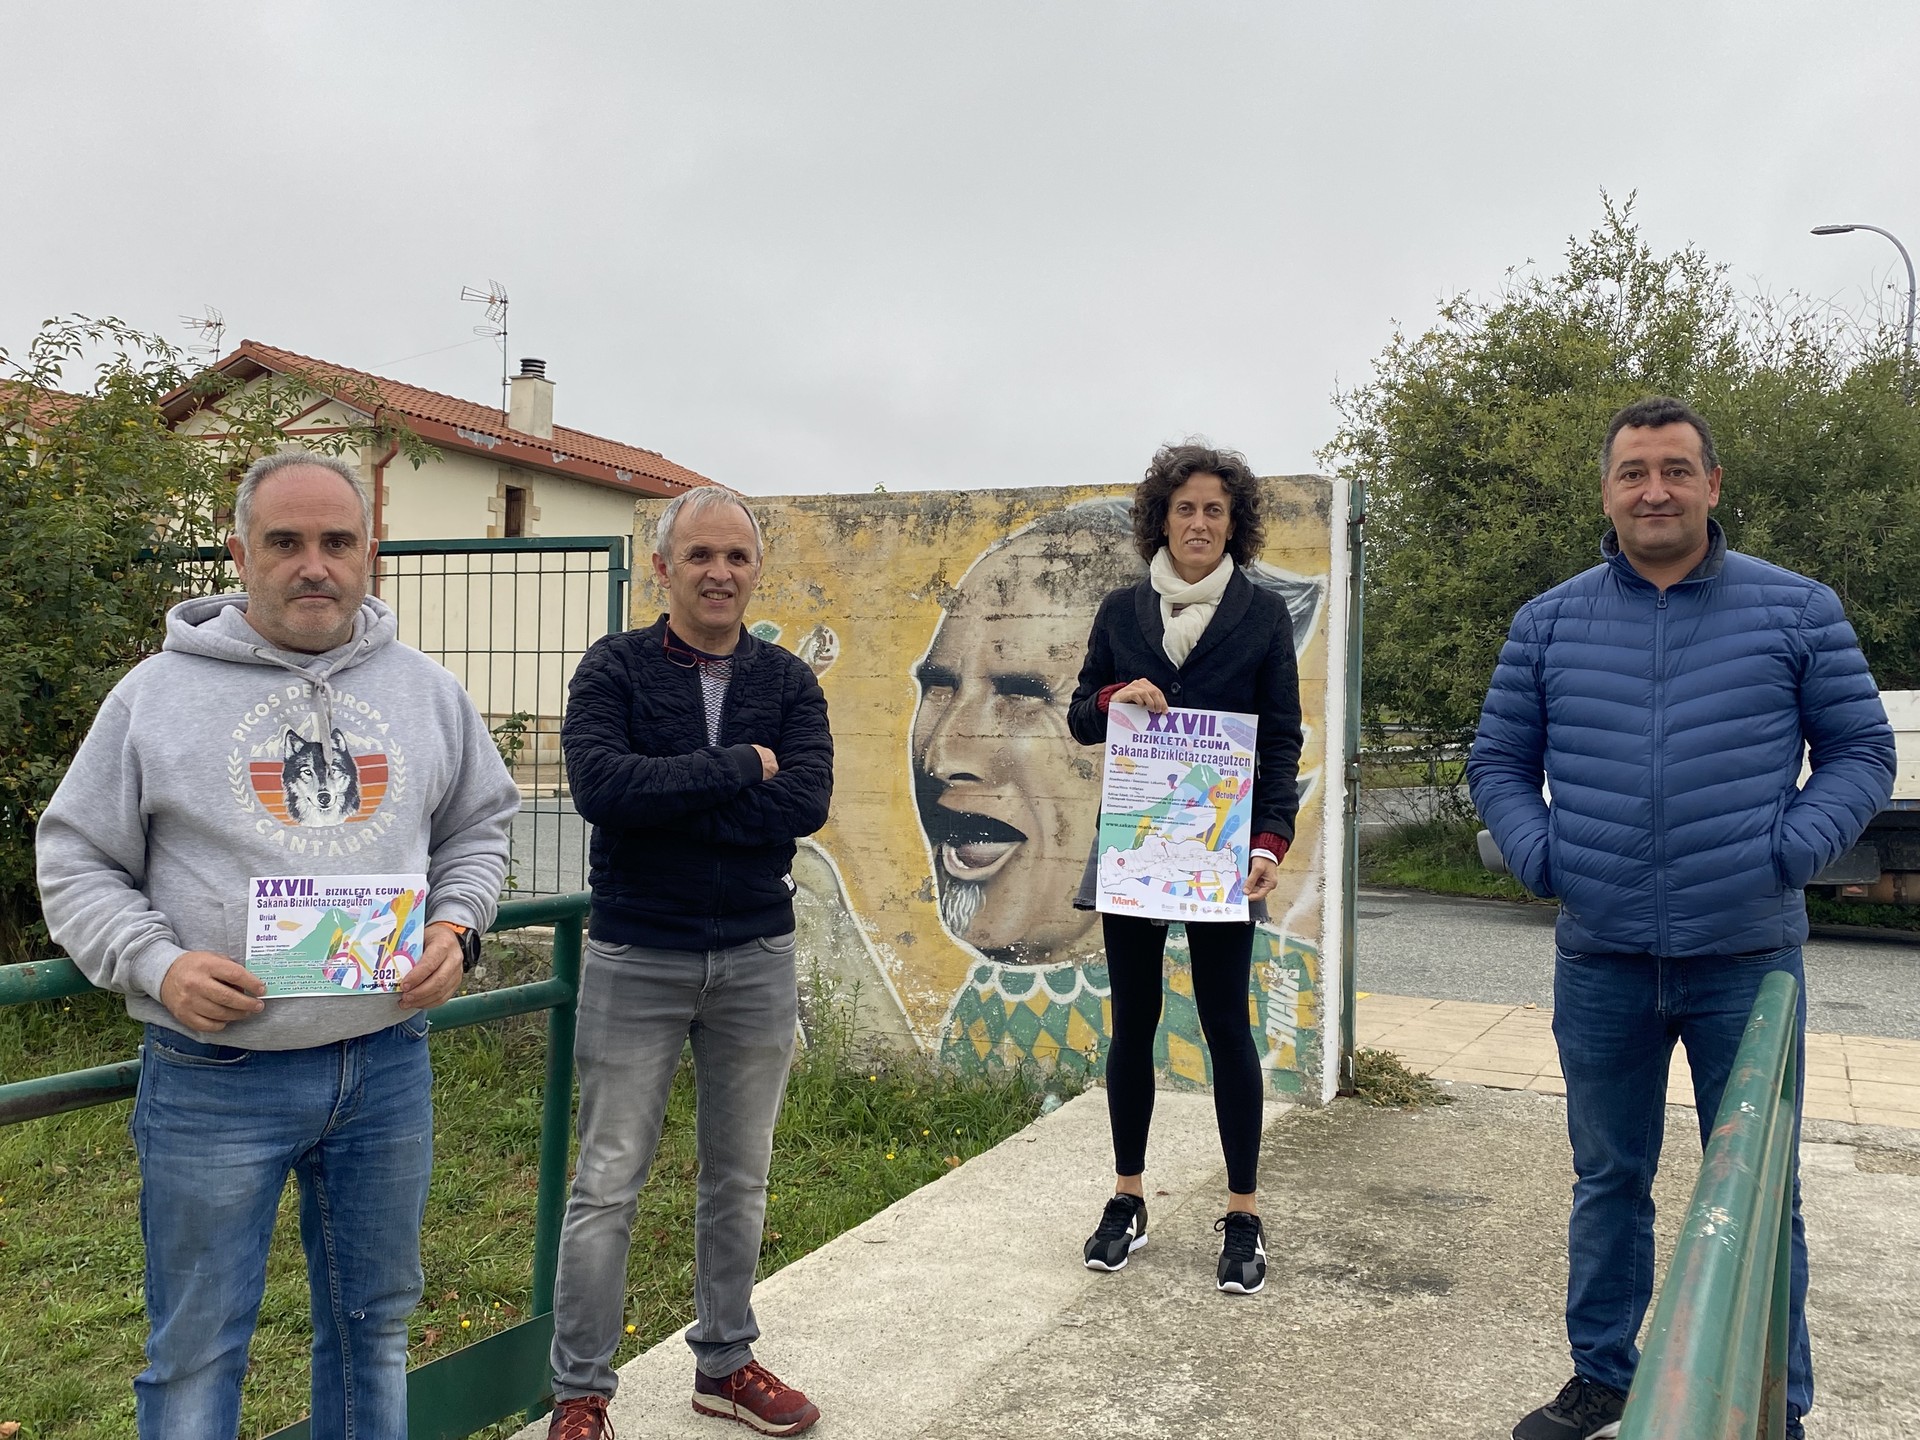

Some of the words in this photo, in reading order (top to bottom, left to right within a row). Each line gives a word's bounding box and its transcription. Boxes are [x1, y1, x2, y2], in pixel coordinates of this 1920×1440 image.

[232, 693, 281, 742] PICOS
[286, 684, 313, 700] DE
[322, 689, 390, 735] UROPA
[1146, 711, 1221, 737] XXVII.
[1132, 733, 1188, 747] BIZIKLETA
[1111, 744, 1149, 758] Sakana
[1219, 768, 1239, 777] Urriak
[1225, 780, 1232, 788] 17
[255, 811, 397, 857] CANTABRIA
[255, 879, 319, 898] XXVII.
[326, 888, 371, 896] BIZIKLETA
[256, 898, 288, 909] Sakana
[1111, 896, 1140, 907] Mank
[373, 969, 396, 980] 2021
